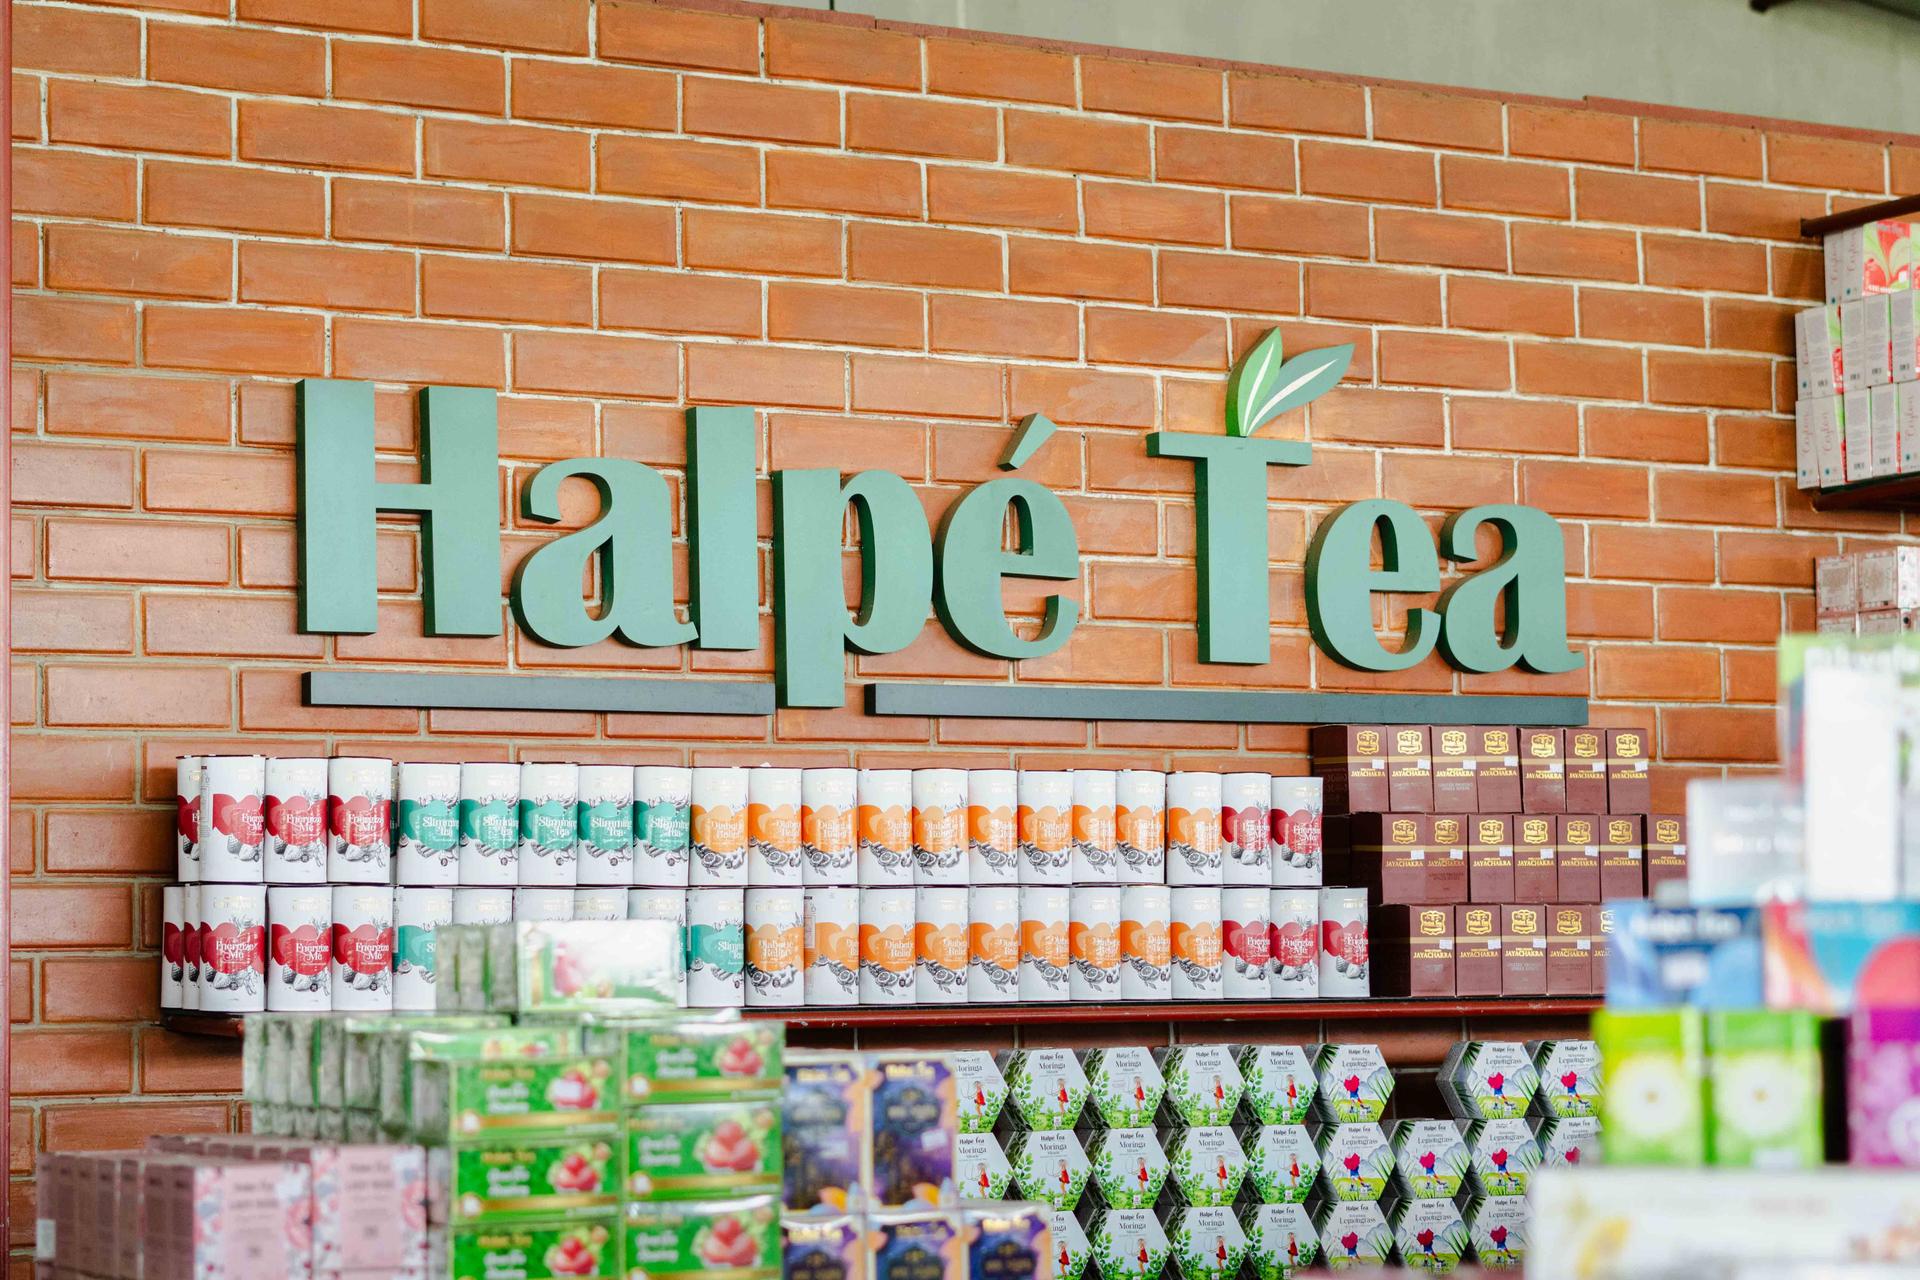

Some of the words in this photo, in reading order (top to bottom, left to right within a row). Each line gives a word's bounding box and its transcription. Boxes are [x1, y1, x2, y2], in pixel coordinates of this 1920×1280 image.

[296, 379, 1081, 708] Halpé
[1146, 430, 1587, 674] Tea
[1199, 1139, 1224, 1147] Moringa
[1119, 1222, 1146, 1230] Moringa
[1198, 1219, 1225, 1227] Moringa
